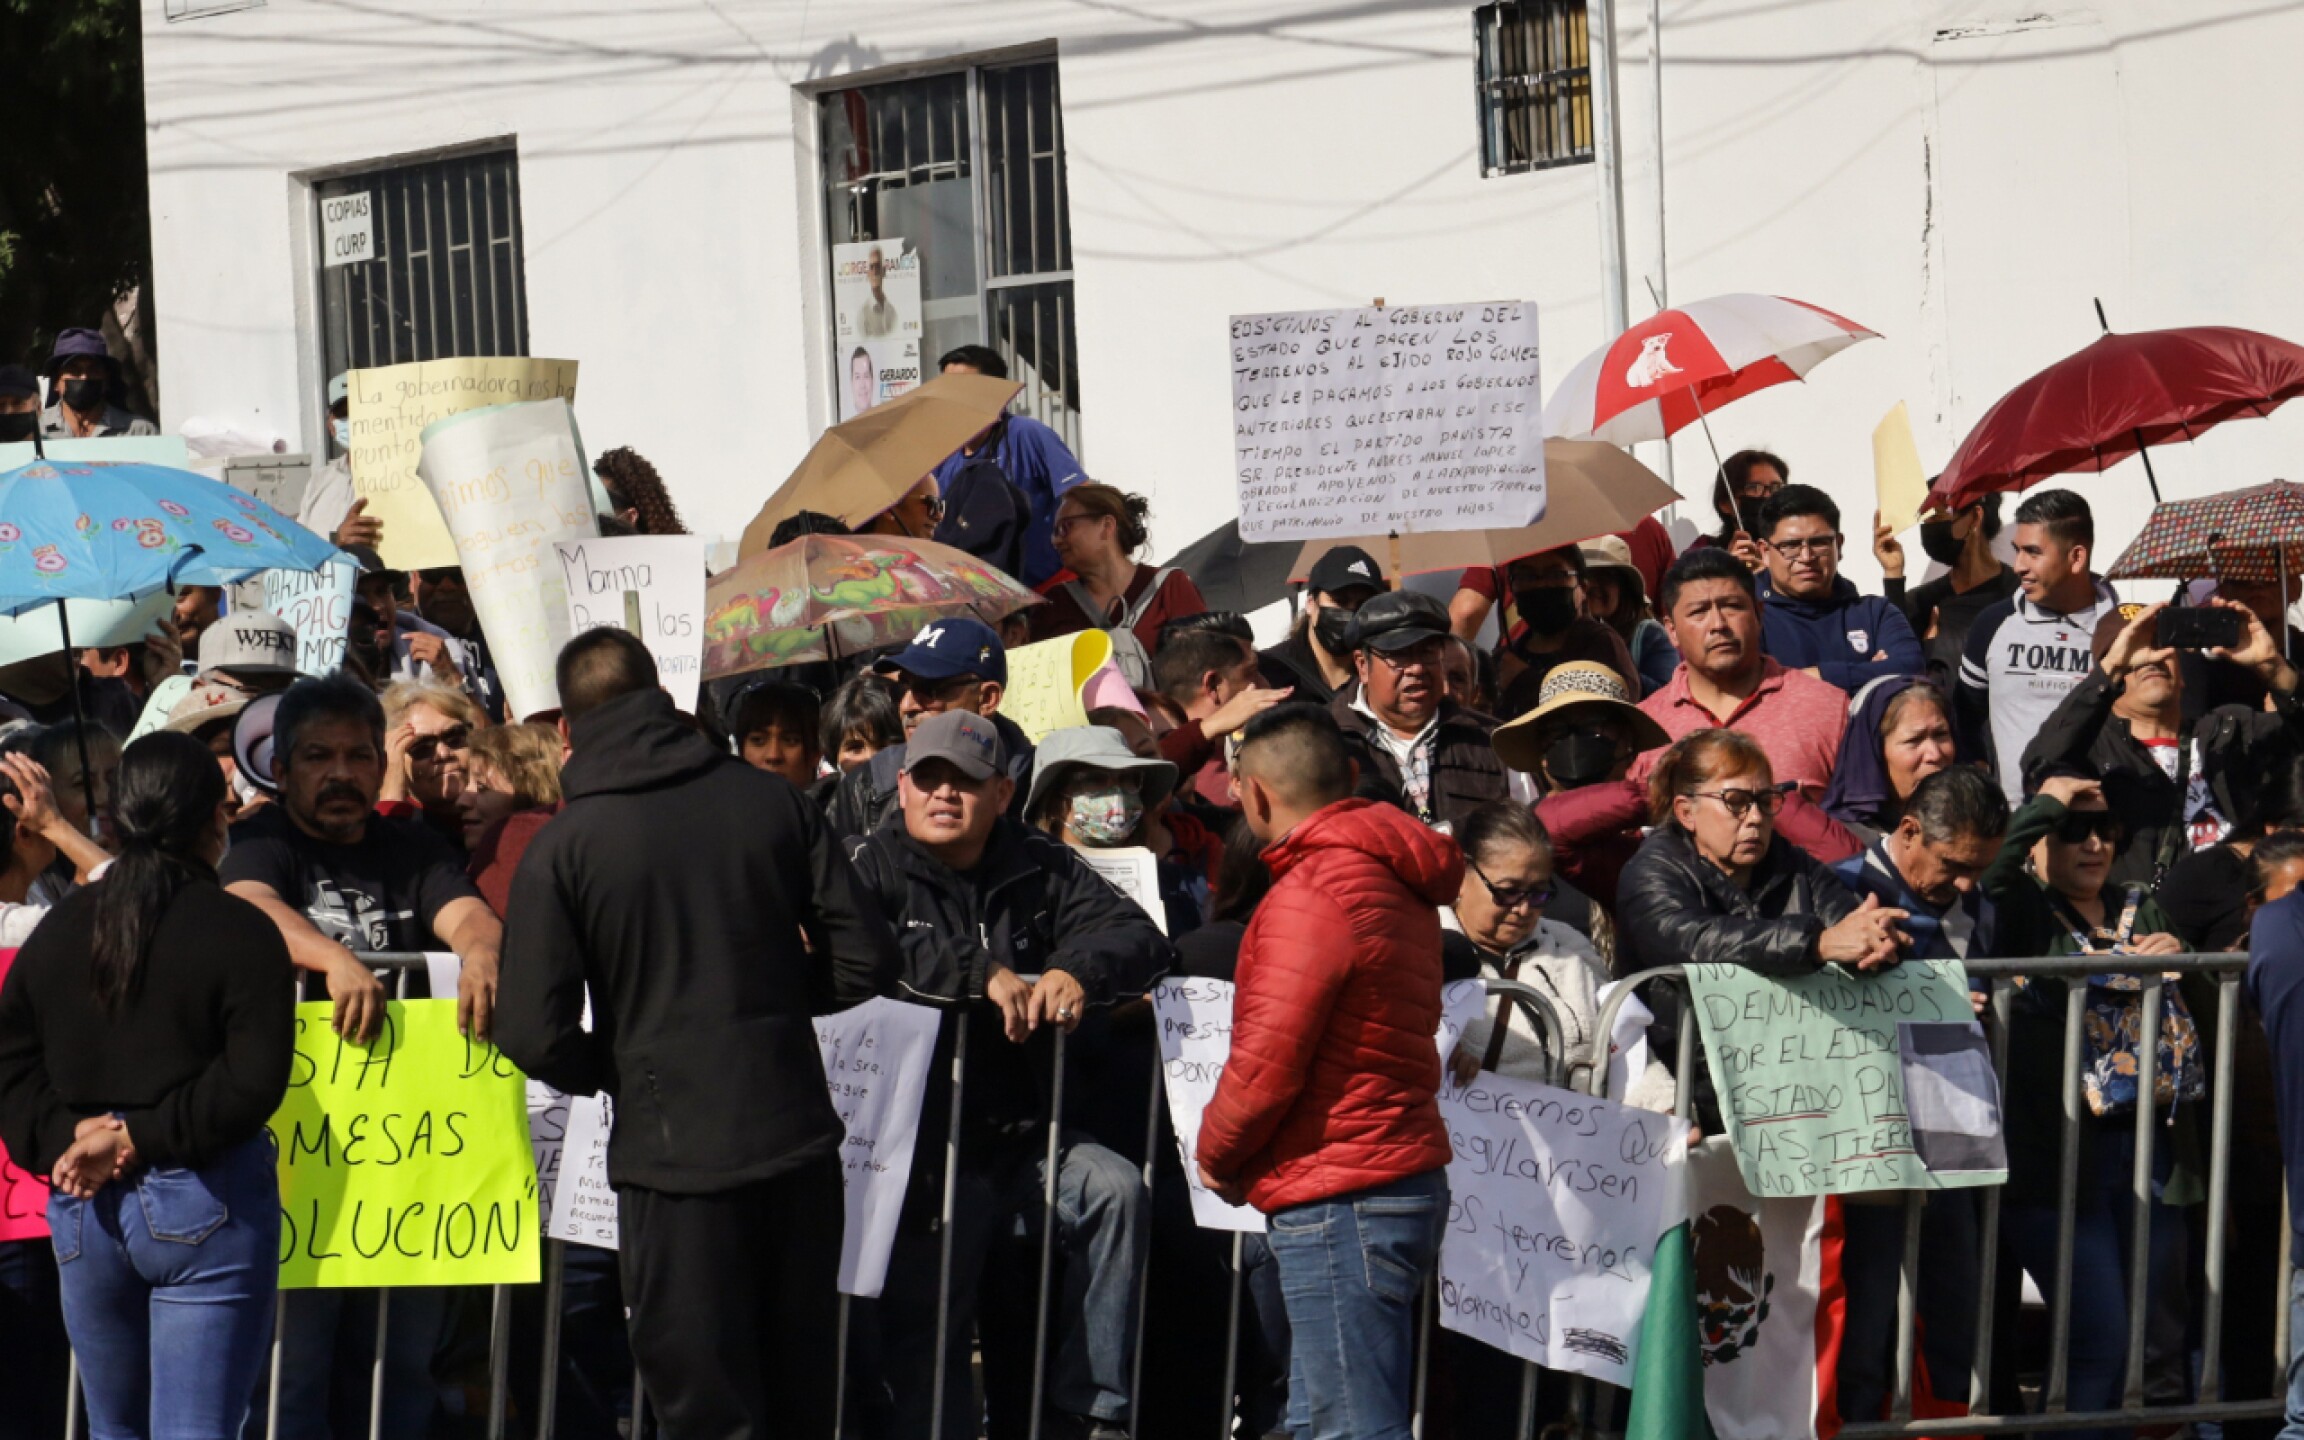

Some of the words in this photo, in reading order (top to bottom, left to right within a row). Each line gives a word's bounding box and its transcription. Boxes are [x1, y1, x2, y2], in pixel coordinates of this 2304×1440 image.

[327, 196, 368, 222] COPIAS
[335, 231, 366, 256] CURP
[1353, 314, 1372, 329] AL
[1481, 307, 1521, 323] DEL
[1234, 342, 1300, 362] ESTADO
[1316, 336, 1361, 355] QUE
[1453, 328, 1497, 344] LOS
[879, 367, 919, 381] GERARDO
[1235, 362, 1329, 382] TERRENOS
[1347, 355, 1364, 370] AL
[1490, 344, 1539, 362] GOMEZ
[356, 370, 382, 404] La
[396, 361, 521, 404] gobernadora
[1238, 394, 1271, 411] QUE
[1281, 390, 1301, 403] LE
[1311, 384, 1392, 405] PAGAMOS
[1422, 379, 1446, 391] LOS
[352, 405, 439, 436] mentido
[1456, 405, 1476, 417] EN
[1490, 402, 1525, 414] ESE
[1320, 442, 1340, 456] EL
[525, 458, 577, 501] que
[1240, 482, 1297, 500] OBRADOR
[1402, 489, 1418, 499] DE
[1361, 512, 1379, 522] DE
[560, 545, 651, 595] Marina
[657, 601, 692, 637] las
[912, 623, 945, 648] M
[296, 636, 349, 671] MOS
[2007, 643, 2091, 674] TOMM
[2028, 680, 2075, 691] HILFIGE
[960, 726, 993, 748] FILA
[1154, 981, 1228, 1011] presi
[1702, 986, 1944, 1031] DEMANDADOS
[1164, 1016, 1233, 1041] prest
[286, 1012, 395, 1091] STA
[1718, 1043, 1765, 1074] POR
[1779, 1034, 1814, 1065] EL
[1732, 1081, 1843, 1117] ESTADO
[1855, 1065, 1907, 1125] PA
[262, 1110, 467, 1167] OMESAS
[1737, 1127, 1810, 1162] LAS
[1818, 1122, 1912, 1160] TIERR
[279, 1176, 537, 1264] OLUCION"
[1493, 1209, 1637, 1283] terrenos
